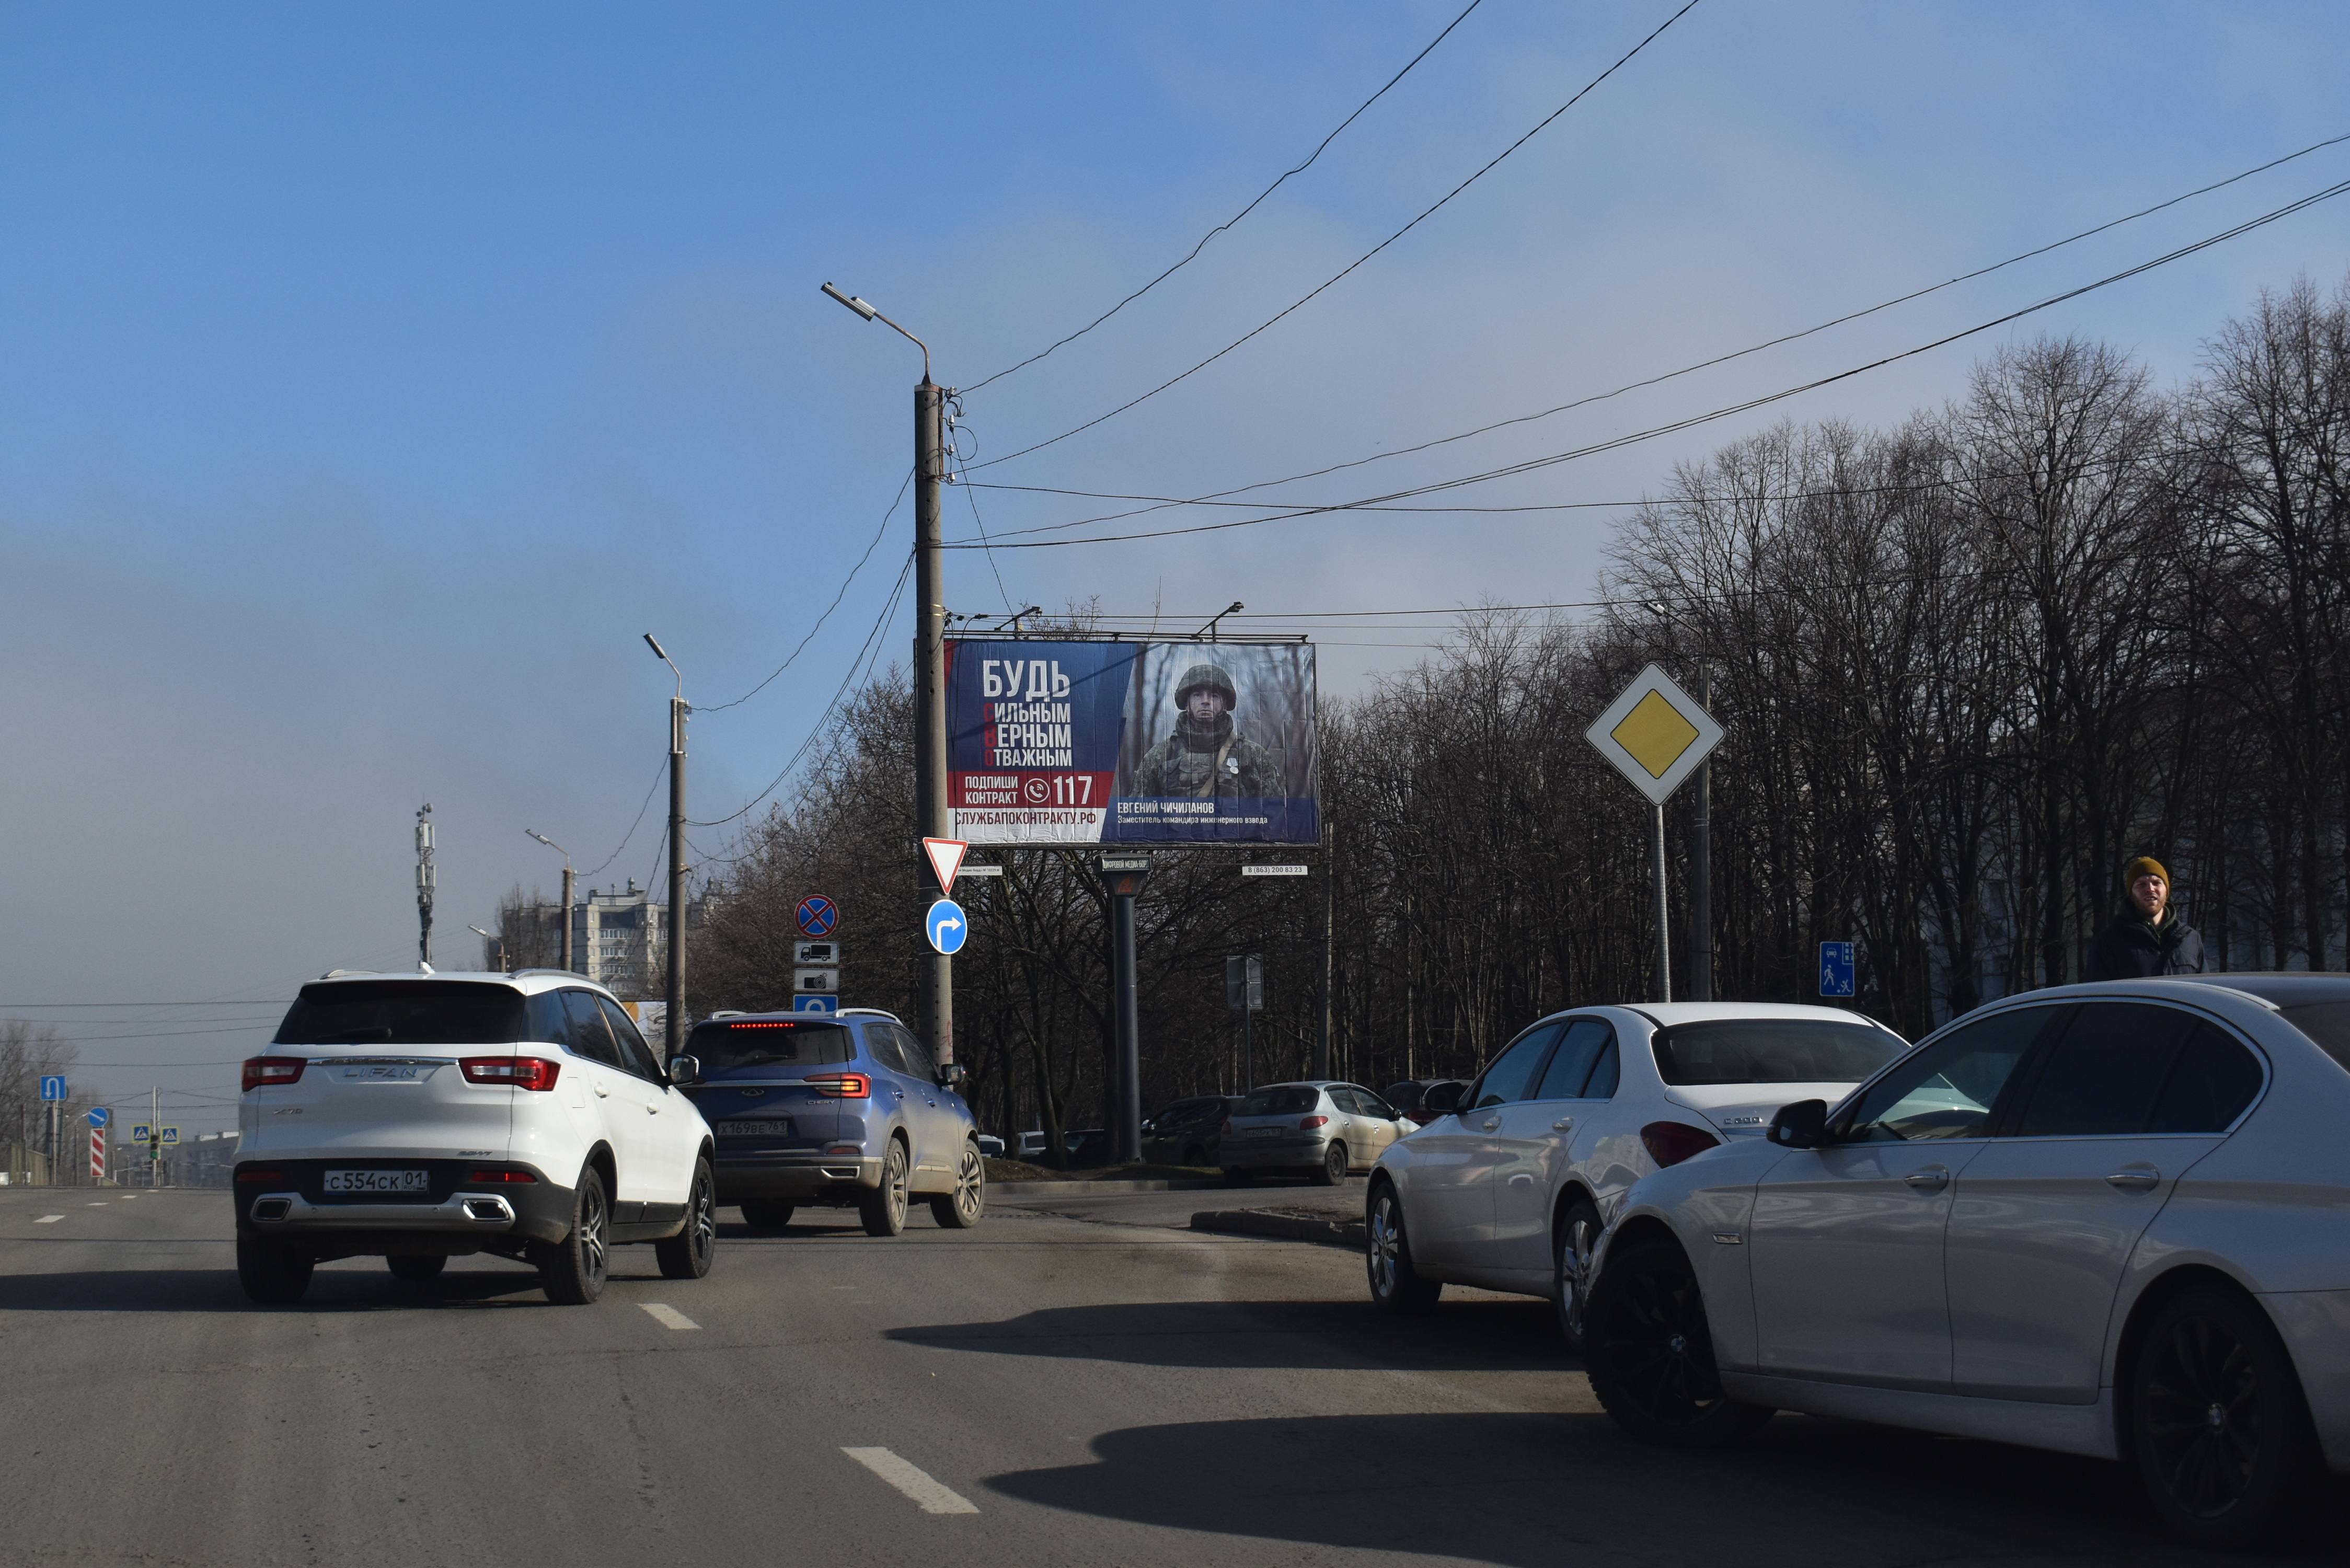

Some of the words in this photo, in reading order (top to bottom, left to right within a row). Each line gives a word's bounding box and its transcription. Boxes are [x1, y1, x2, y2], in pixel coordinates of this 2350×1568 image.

[983, 660, 1070, 702] БУДЬ
[983, 702, 1070, 723] СИЛЬНЫМ
[984, 723, 1072, 747] ВЕРНЫМ
[985, 748, 1072, 766] ОТВАЖНЫМ
[965, 776, 1018, 790] ПОДПИШИ
[1053, 775, 1092, 805] 117
[965, 791, 1018, 804] КОНТРАКТ
[1118, 800, 1159, 814] ЕВГЕНИЙ
[1160, 802, 1215, 814] ЧИЧИЛАНОВ
[956, 811, 1097, 825] СЛУЖБАПОКОНТРАКТУ.РФ
[1118, 815, 1161, 824] Заместитель
[1200, 816, 1243, 825] инженерного
[1245, 816, 1268, 825] взвода
[1103, 860, 1124, 869] ЦИФРОВОЙ
[343, 1067, 419, 1078] LIFAN
